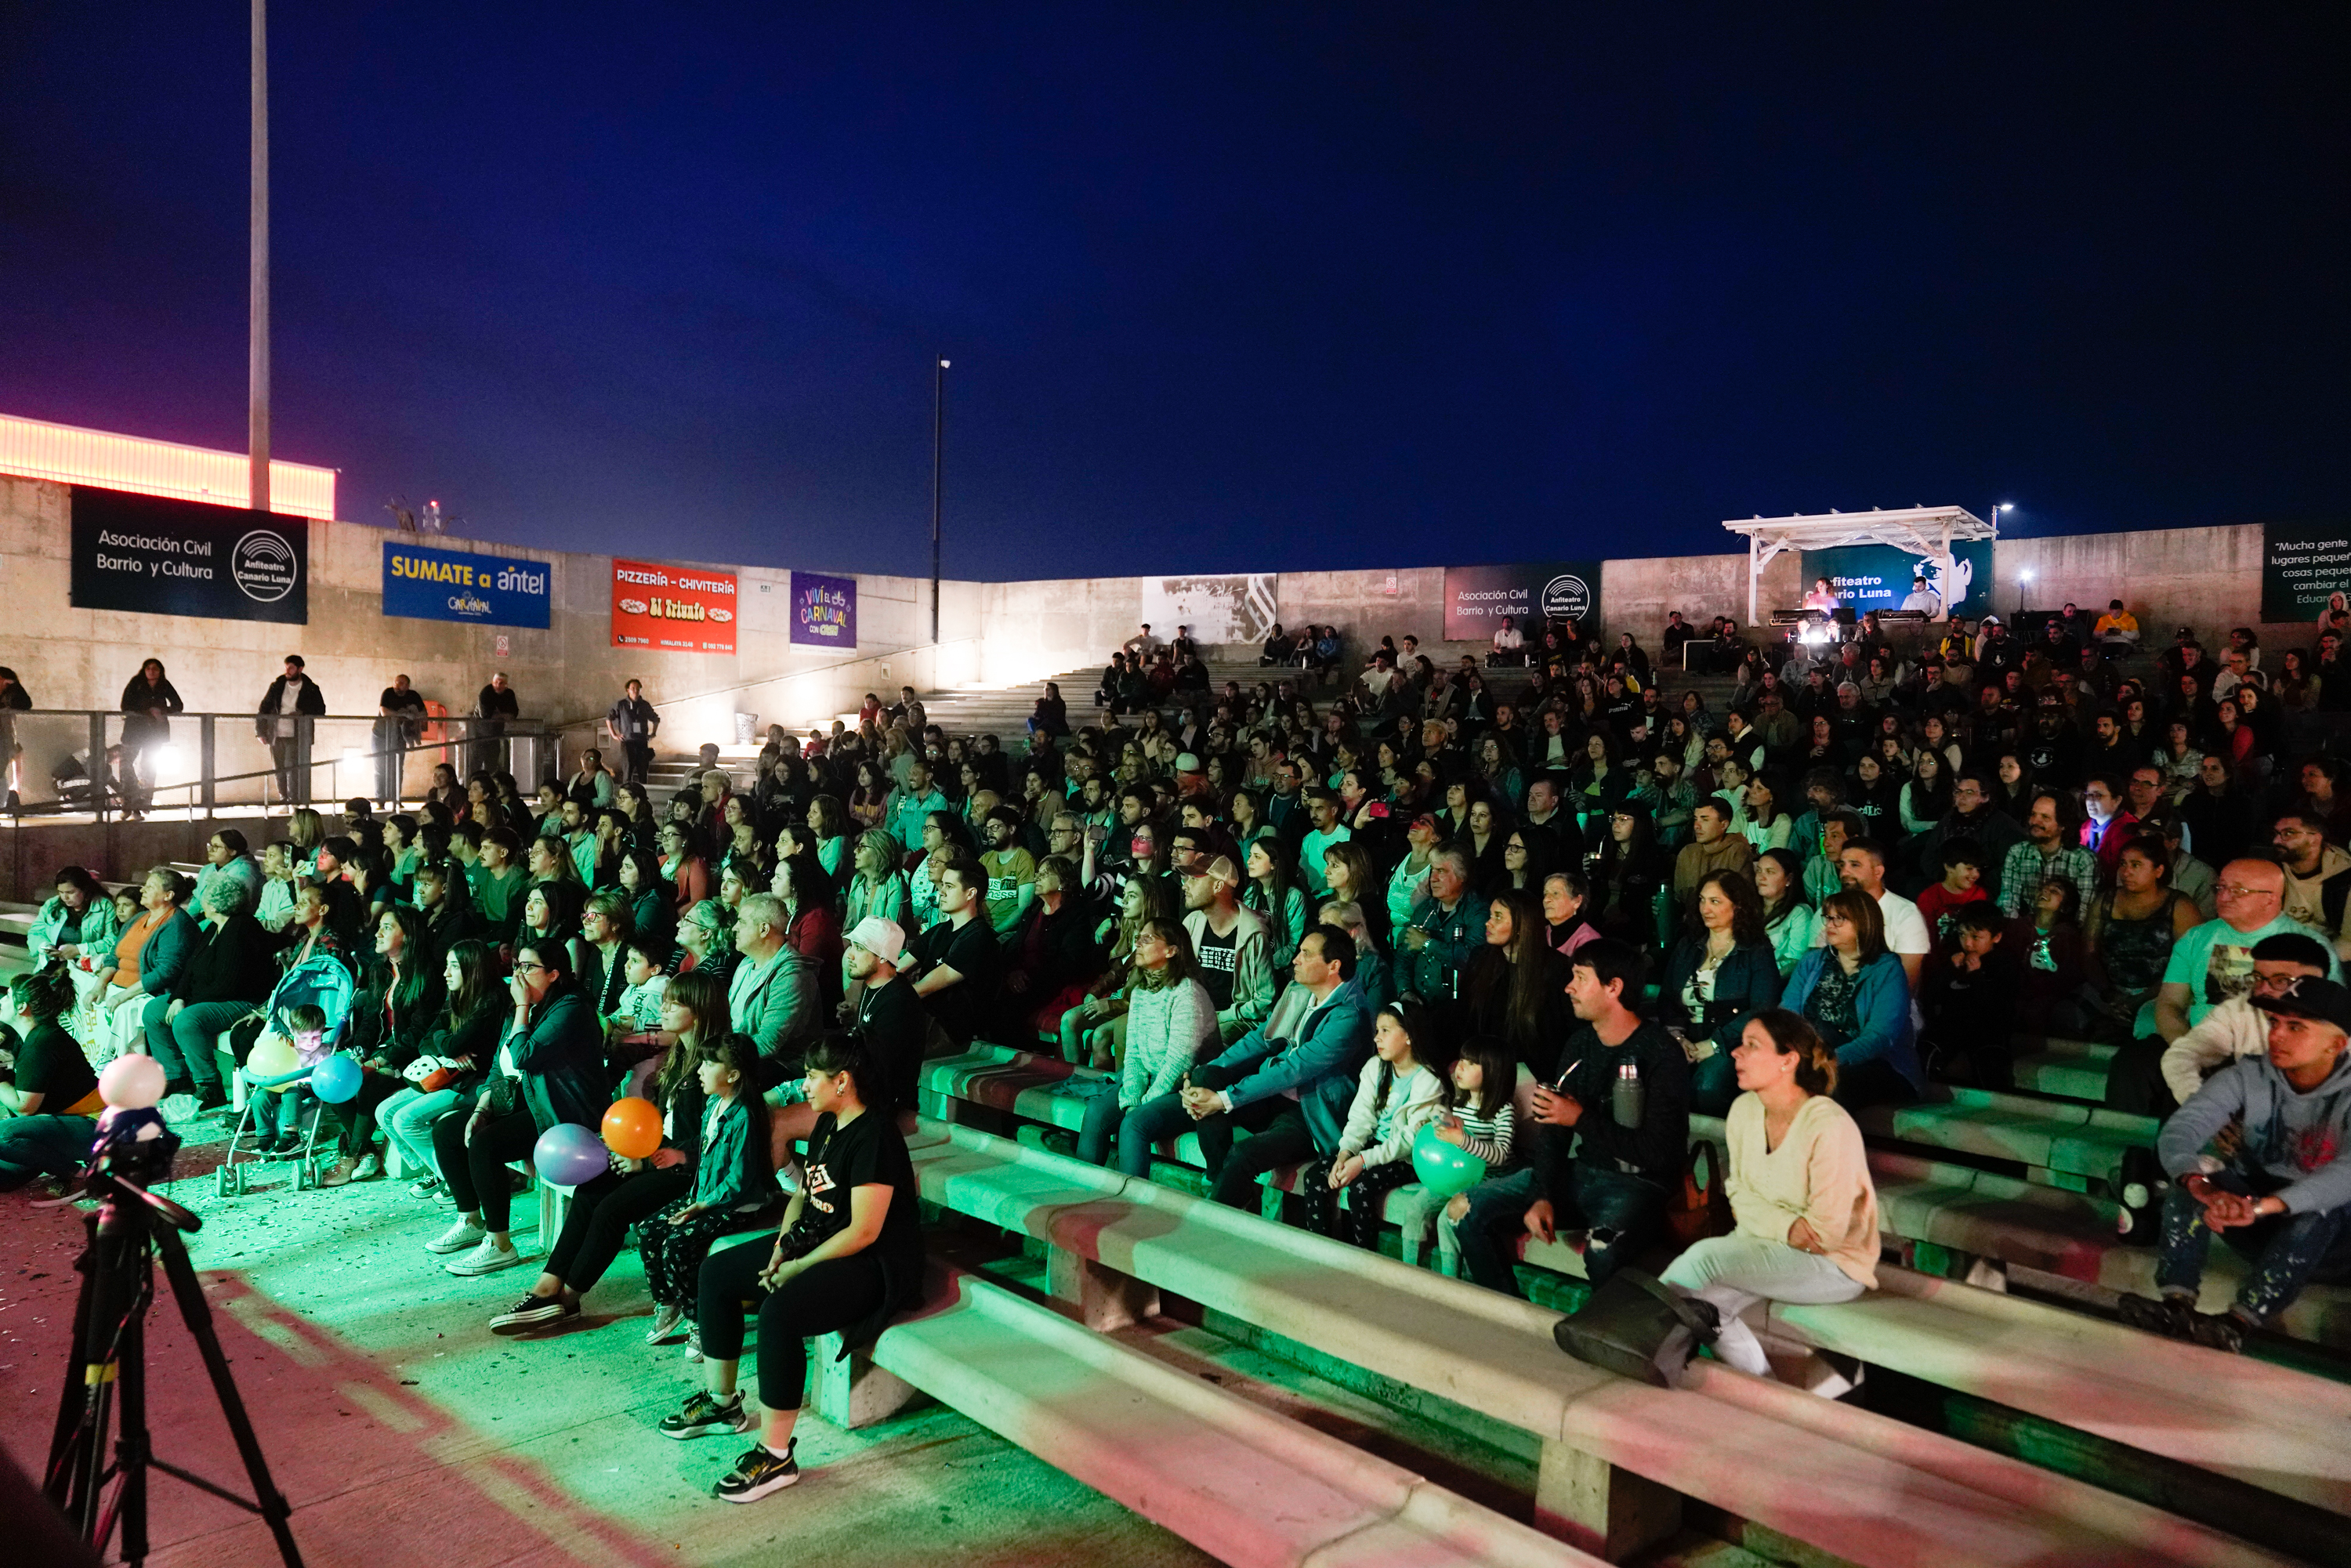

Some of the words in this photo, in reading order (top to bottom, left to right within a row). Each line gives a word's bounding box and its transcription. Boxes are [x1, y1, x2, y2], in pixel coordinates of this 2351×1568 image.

[98, 529, 180, 552] Asociación
[183, 540, 212, 556] Civil
[2317, 539, 2348, 551] gente
[97, 553, 142, 572] Barrio
[150, 562, 159, 578] y
[162, 561, 213, 580] Cultura
[245, 559, 285, 572] Anfiteatro
[2271, 556, 2310, 567] lugares
[237, 570, 270, 582] Canario
[271, 574, 292, 585] Luna
[391, 556, 473, 585] SUMATE
[479, 574, 491, 588] a
[497, 566, 544, 595] antel
[2282, 569, 2313, 578] cosas
[2315, 567, 2351, 578] peque
[617, 569, 668, 586] PIZZERÍA
[679, 578, 734, 595] CHIVITERÍA
[2293, 581, 2337, 591] cambiar
[2339, 579, 2349, 588] el
[824, 592, 831, 603] EL
[1458, 590, 1507, 601] Asociación
[1509, 588, 1528, 599] Civil
[1859, 588, 1892, 599] Luna
[650, 597, 662, 617] El
[665, 599, 705, 621] Triunfo
[1457, 606, 1483, 616] Barrio
[1488, 608, 1494, 617] y
[1495, 605, 1529, 615] Cultura
[801, 606, 846, 628] CARNAVAL
